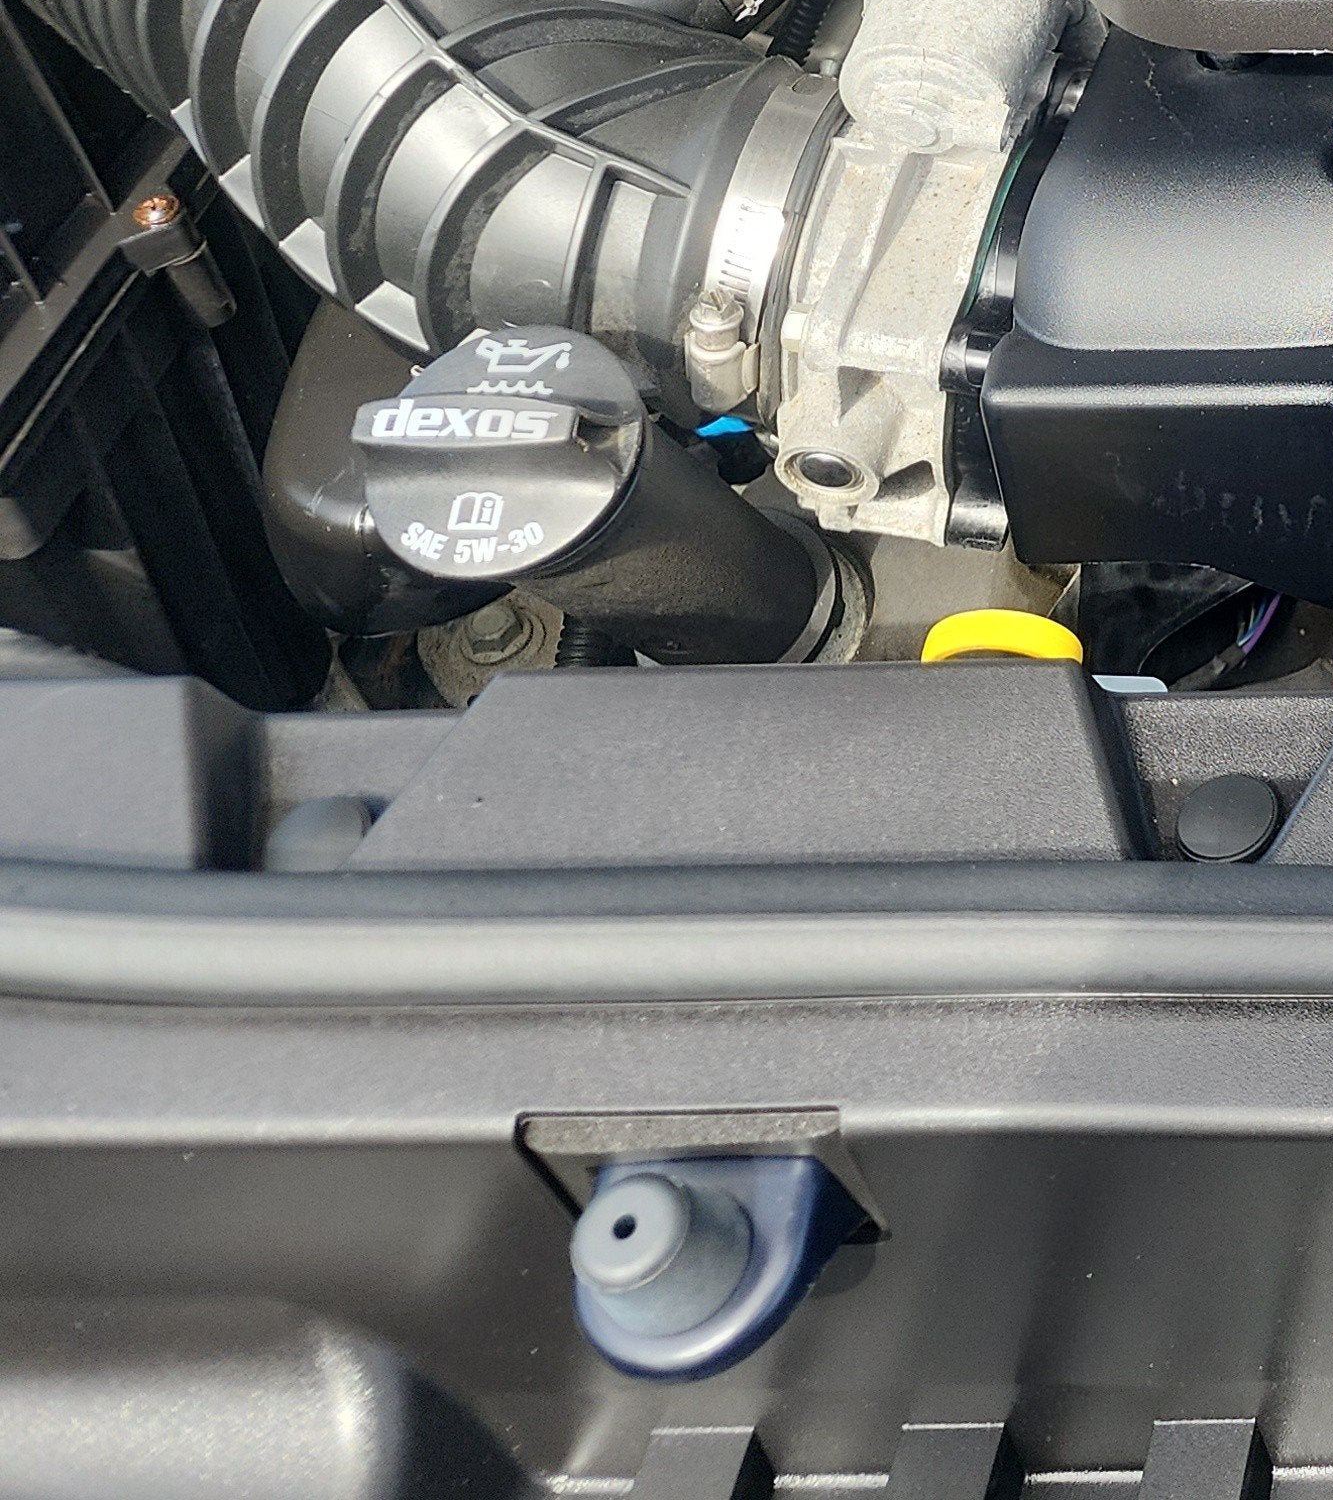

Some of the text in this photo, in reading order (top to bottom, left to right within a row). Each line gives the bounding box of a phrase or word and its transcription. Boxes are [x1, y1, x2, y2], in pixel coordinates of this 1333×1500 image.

[371, 399, 558, 440] dexos
[401, 521, 545, 564] SAE 5W-30
